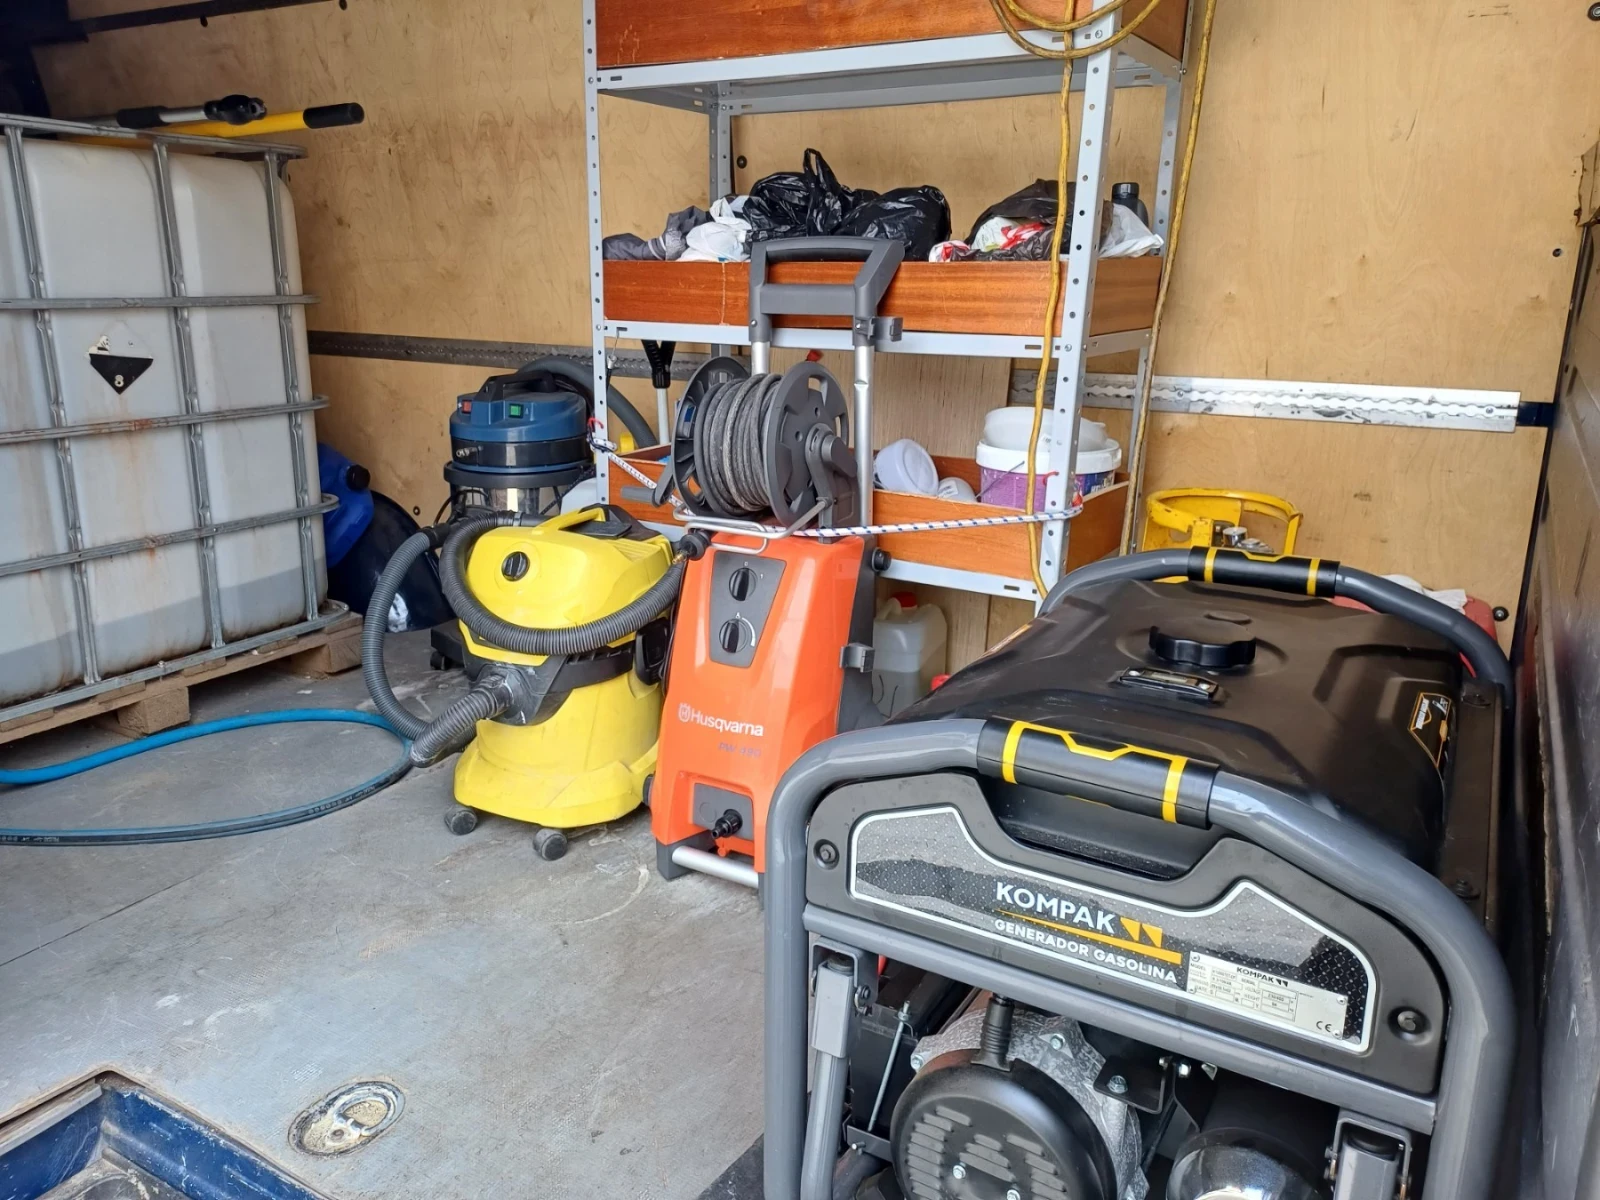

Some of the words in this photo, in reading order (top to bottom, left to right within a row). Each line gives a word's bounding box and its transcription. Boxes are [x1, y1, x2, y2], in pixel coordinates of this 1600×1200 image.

[114, 374, 124, 387] 8
[690, 708, 764, 737] Husqvarna
[995, 881, 1117, 935] KOMPAK
[993, 918, 1090, 958] GENERADOR
[1093, 948, 1178, 984] GASOLINA
[1190, 962, 1206, 971] MODEL
[1236, 966, 1274, 984] KOMPAK
